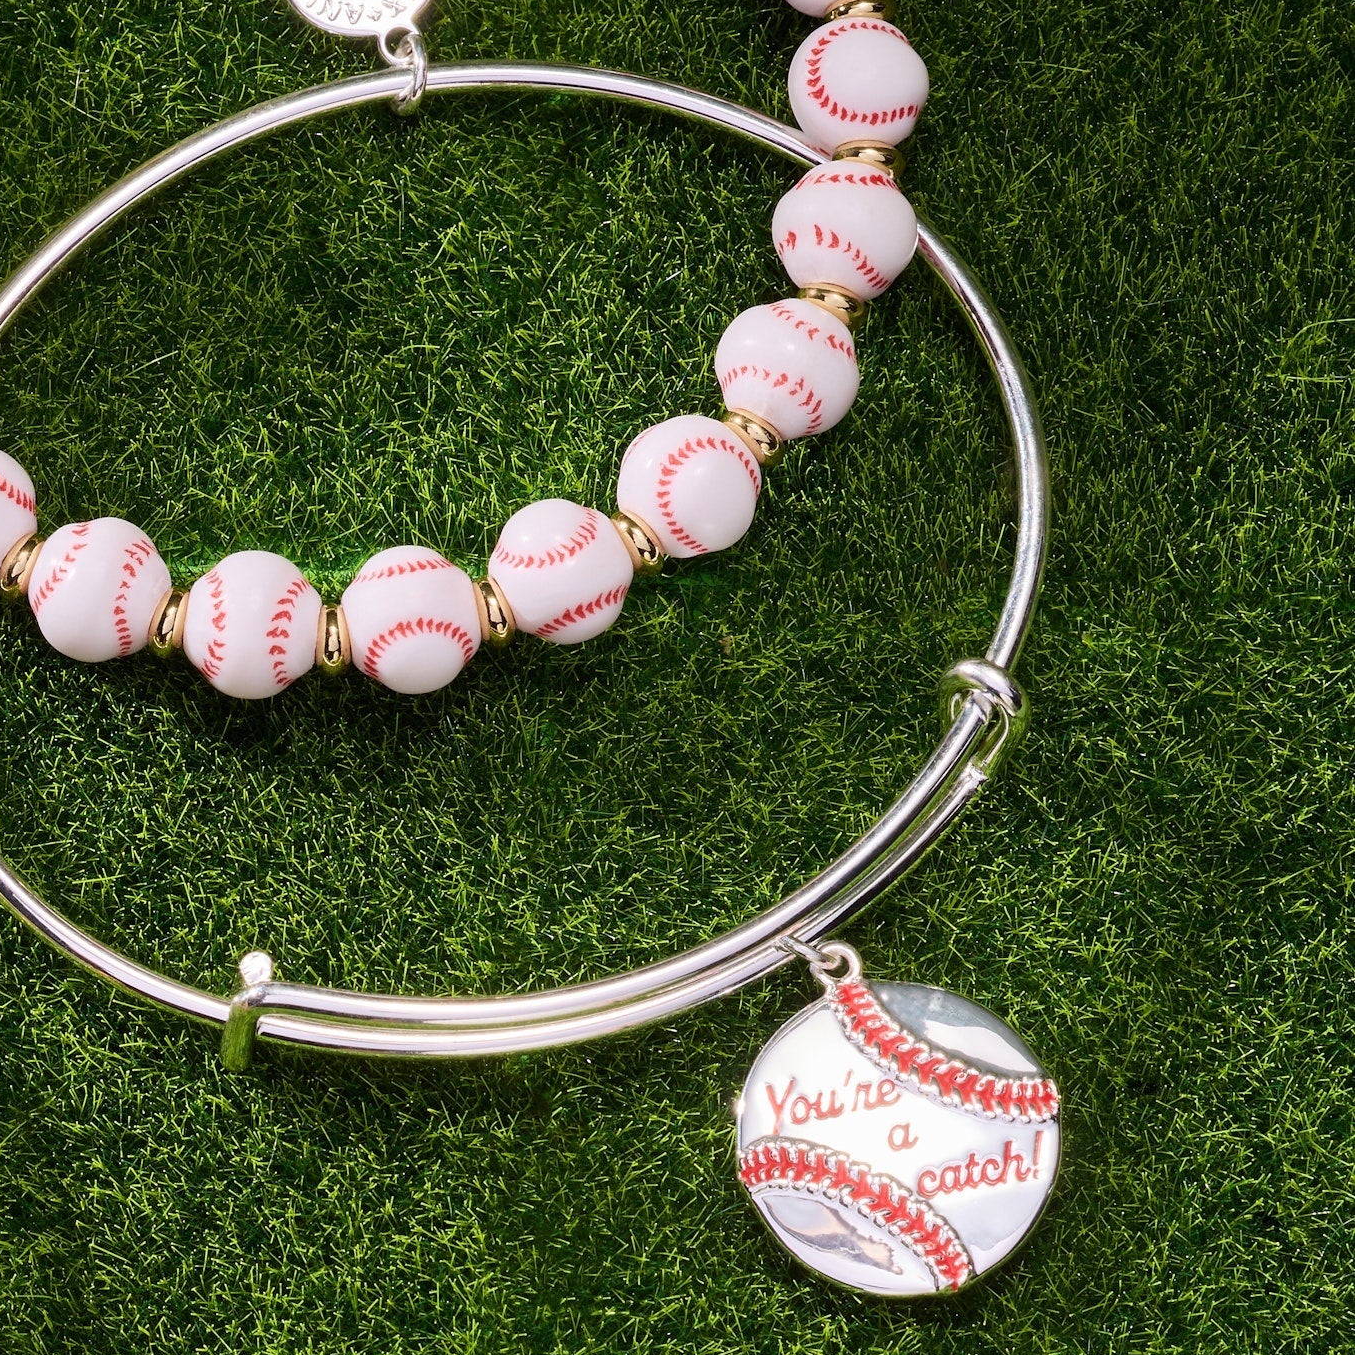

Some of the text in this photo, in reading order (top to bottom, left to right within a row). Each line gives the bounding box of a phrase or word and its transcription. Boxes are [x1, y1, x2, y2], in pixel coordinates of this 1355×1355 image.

[765, 1070, 900, 1136] You're
[887, 1122, 919, 1152] a
[916, 1130, 1045, 1199] catch!
